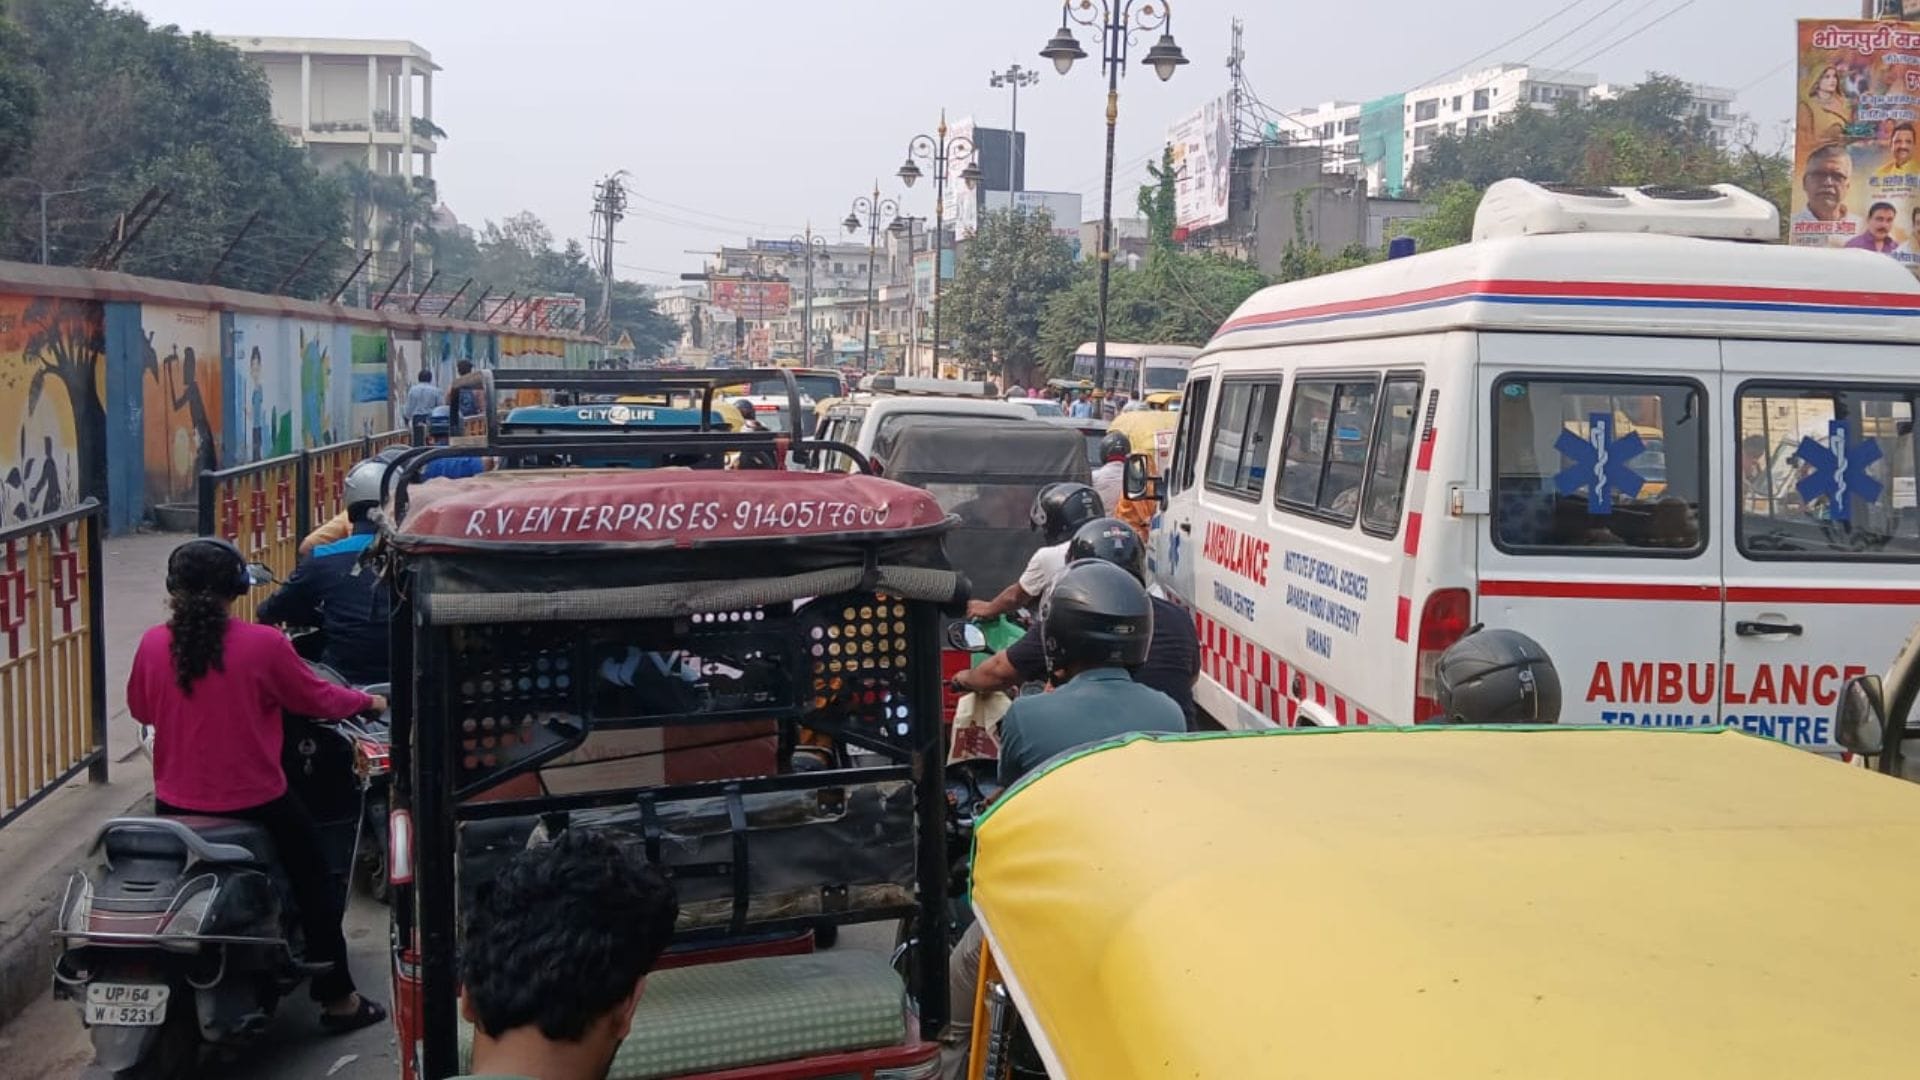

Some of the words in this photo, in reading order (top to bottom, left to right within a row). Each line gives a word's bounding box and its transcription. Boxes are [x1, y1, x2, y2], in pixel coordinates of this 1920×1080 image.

[1814, 25, 1890, 54] भोजपुरी
[578, 409, 608, 420] CITY
[631, 409, 655, 420] LIFE
[1203, 520, 1270, 588] AMBULANCE
[106, 987, 125, 1001] UP
[96, 1008, 106, 1021] W
[120, 1008, 154, 1022] 5231
